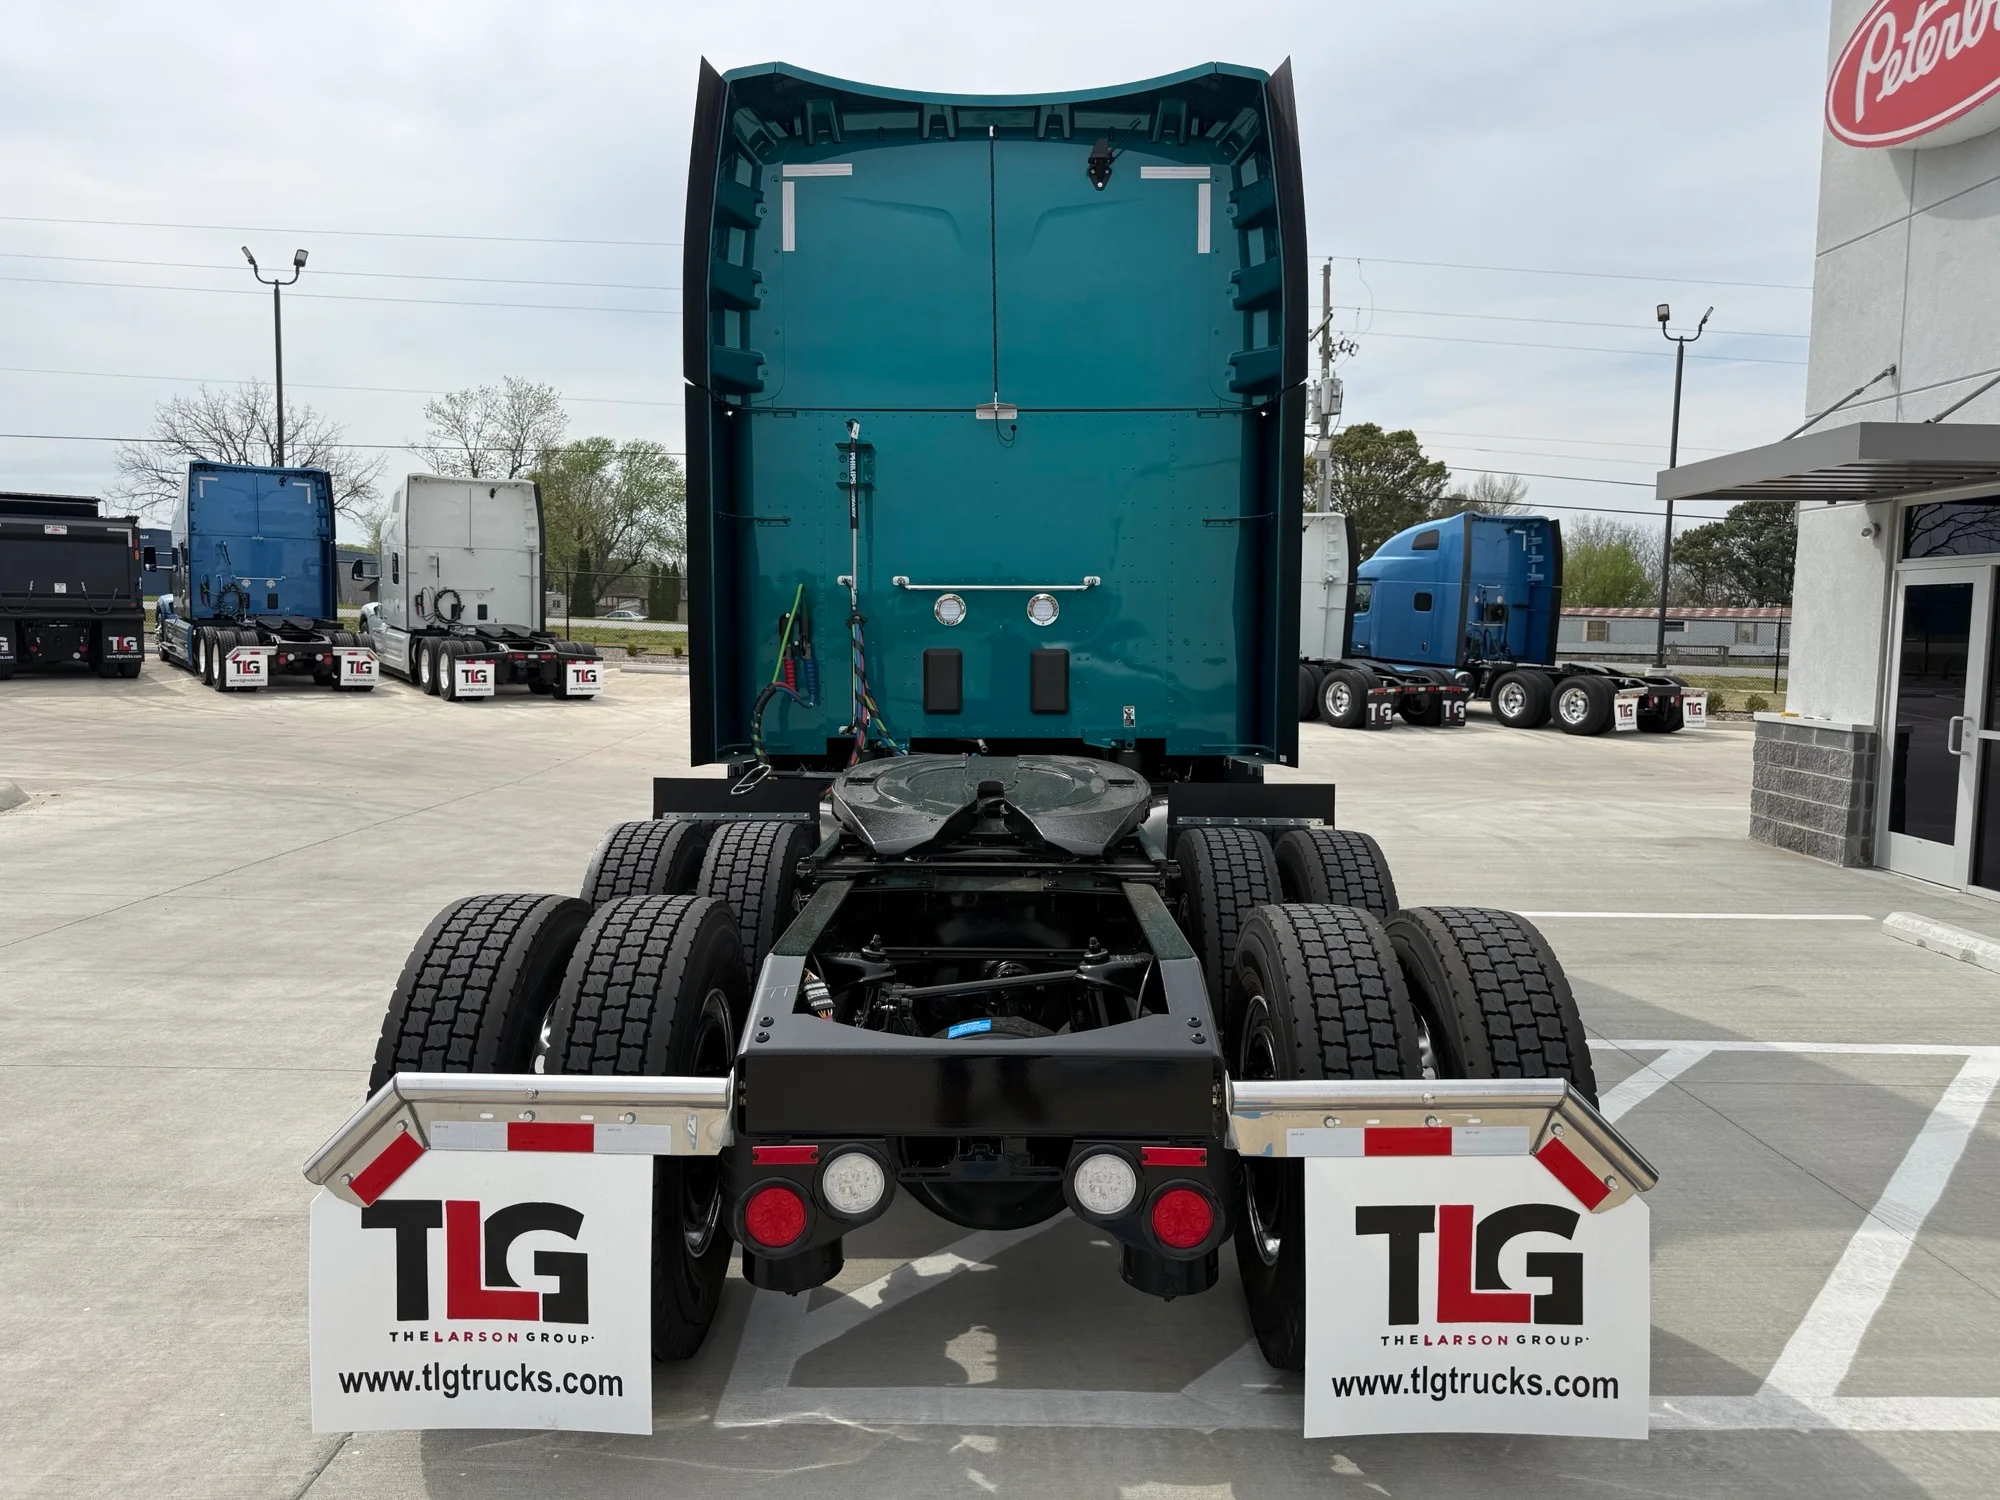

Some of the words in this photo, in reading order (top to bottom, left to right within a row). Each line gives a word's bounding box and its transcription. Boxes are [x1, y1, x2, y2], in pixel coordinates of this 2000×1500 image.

[108, 635, 138, 651] TLG
[232, 660, 260, 674] TLG
[346, 660, 372, 675] TLG
[461, 669, 487, 683] TLG
[572, 669, 597, 683] TLG
[1368, 702, 1392, 721] TG
[1443, 700, 1465, 719] TG
[1618, 704, 1633, 718] TLG
[1686, 703, 1702, 716] TLG
[361, 1199, 589, 1325] TLG
[1355, 1203, 1584, 1326] TLG
[389, 1331, 429, 1343] THE
[434, 1331, 518, 1343] LARSON
[526, 1332, 590, 1345] GROUP
[1380, 1335, 1419, 1347] THE
[1424, 1334, 1509, 1347] LARSON
[1516, 1334, 1584, 1347] GROUP
[338, 1362, 624, 1399] www.tlgtrucks.com
[1331, 1365, 1619, 1402] www.tlgtrucks.com
